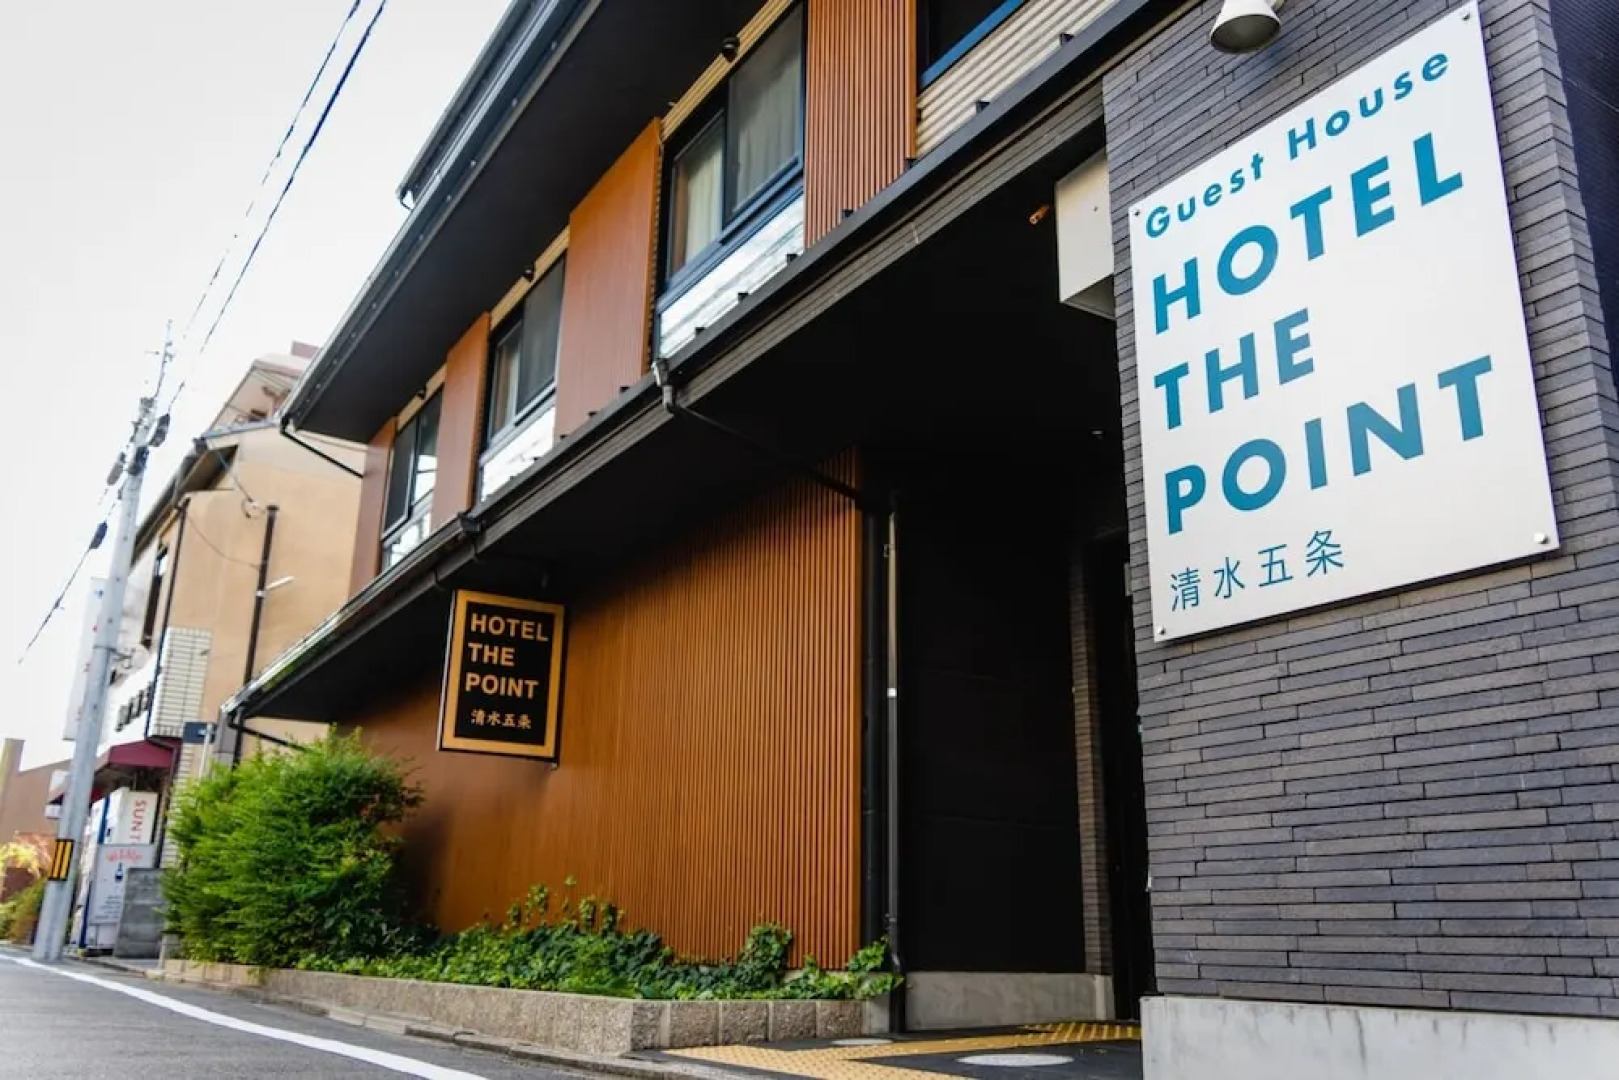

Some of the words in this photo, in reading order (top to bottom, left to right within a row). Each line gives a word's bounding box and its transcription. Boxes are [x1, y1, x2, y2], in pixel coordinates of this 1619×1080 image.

[1145, 153, 1265, 240] Guest
[1286, 51, 1450, 161] House
[1151, 131, 1465, 336] HOTEL
[1153, 308, 1315, 430] THE
[1164, 355, 1494, 536] POINT
[1170, 530, 1345, 612] 清水五条
[468, 642, 515, 666] THE
[471, 613, 549, 641] HOTEL
[465, 672, 539, 699] POINT
[471, 709, 532, 729] 清水五条
